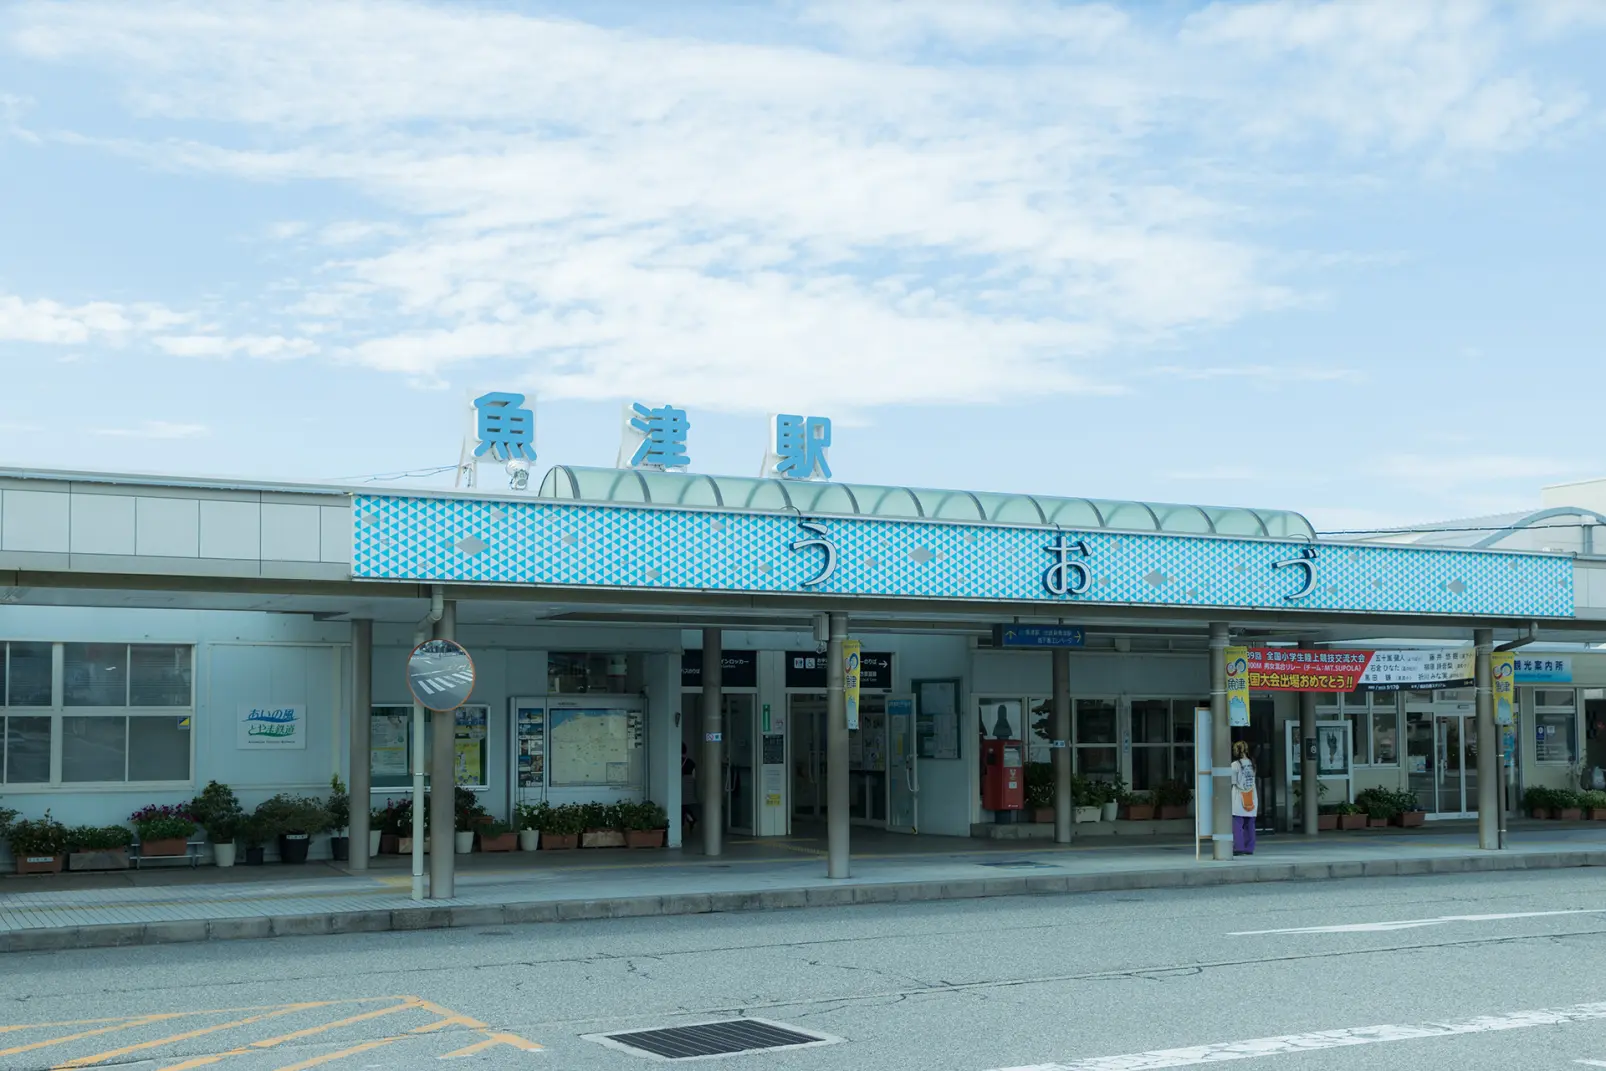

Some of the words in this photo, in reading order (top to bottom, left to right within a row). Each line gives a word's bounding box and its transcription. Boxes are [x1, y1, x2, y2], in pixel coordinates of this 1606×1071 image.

[472, 391, 833, 480] 魚津駅
[1227, 678, 1246, 691] 魚津
[1247, 673, 1353, 689] 国大会出場おめでとう!!
[247, 708, 297, 723] あいの風
[247, 723, 297, 737] とやま鉄道
